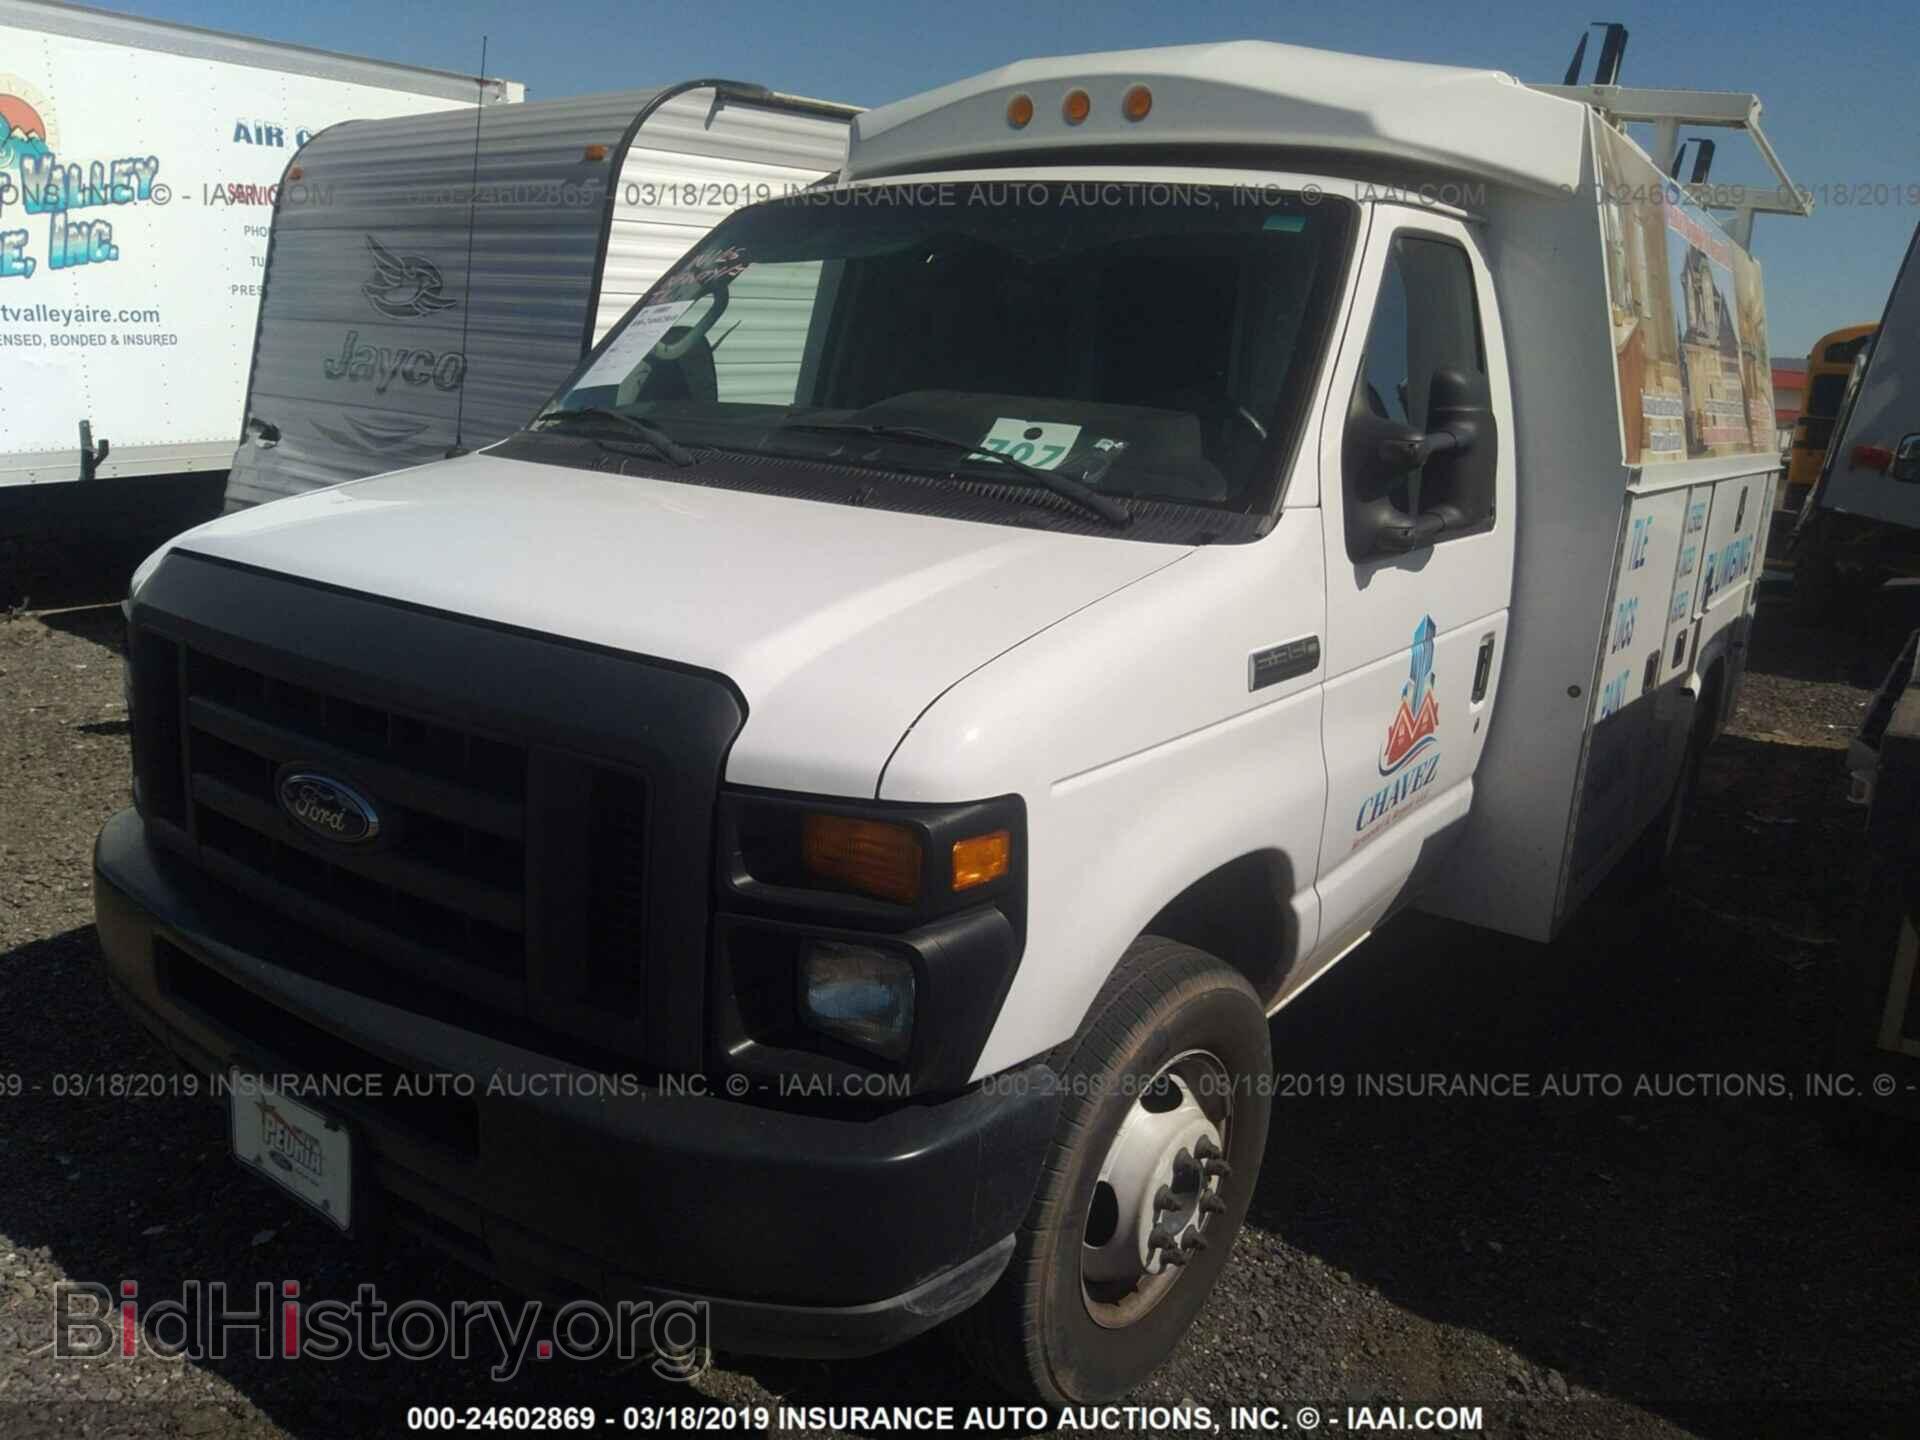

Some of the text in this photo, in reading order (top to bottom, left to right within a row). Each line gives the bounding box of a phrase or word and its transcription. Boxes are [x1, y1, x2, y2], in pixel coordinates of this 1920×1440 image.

[233, 120, 284, 147] AIR
[20, 152, 159, 214] VALLEY
[1, 304, 161, 327] tvalleyaire.com
[50, 333, 107, 347] BONDED
[110, 334, 120, 346] &
[123, 333, 178, 348] INSURED
[323, 330, 468, 395] Jayco
[295, 784, 346, 834] Ford
[1356, 752, 1441, 832] CHAVEZ
